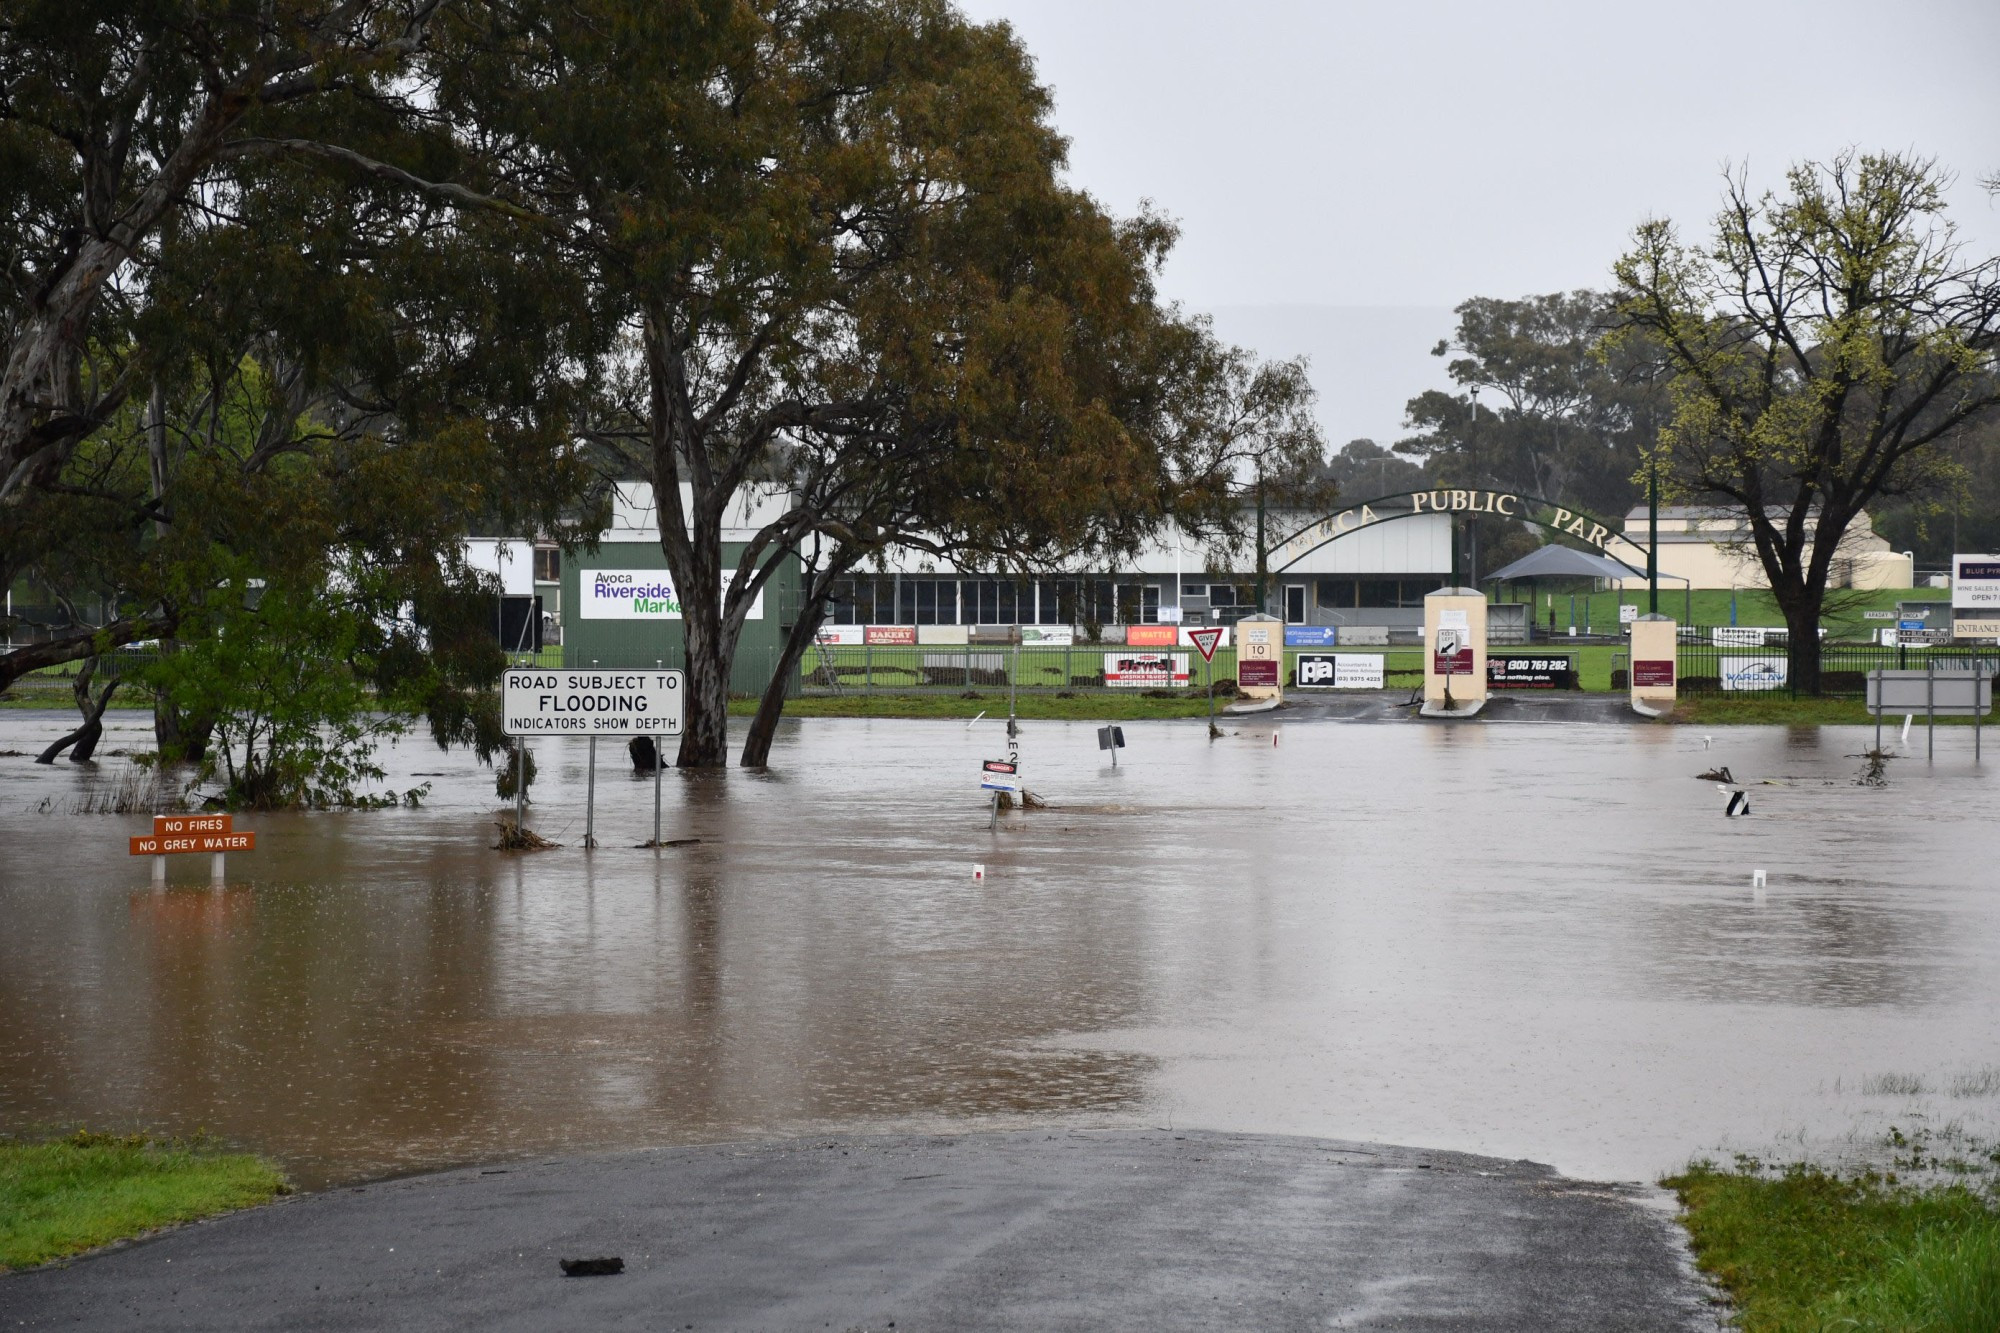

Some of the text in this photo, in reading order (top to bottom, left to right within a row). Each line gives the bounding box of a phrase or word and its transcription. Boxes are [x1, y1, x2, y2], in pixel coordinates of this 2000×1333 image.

[1412, 490, 1517, 516] PUBLIC
[1966, 567, 1985, 575] BLUE
[595, 572, 632, 583] Avoca
[595, 583, 671, 599] Riverside
[634, 598, 682, 613] Marke
[1957, 624, 1999, 633] ENTRANCE
[1252, 646, 1264, 654] 10
[1118, 660, 1176, 672] Howel
[1508, 660, 1567, 670] 1300 769 282
[1727, 673, 1784, 681] WARDLAW
[510, 677, 677, 689] ROAD SUBJECT TO
[539, 696, 648, 711] FLOODING
[510, 718, 677, 729] INDICATORS SHOW DEPTH
[1010, 752, 1018, 763] 2
[165, 820, 223, 831] NO FIRES
[139, 837, 247, 851] NO GREY WATER
